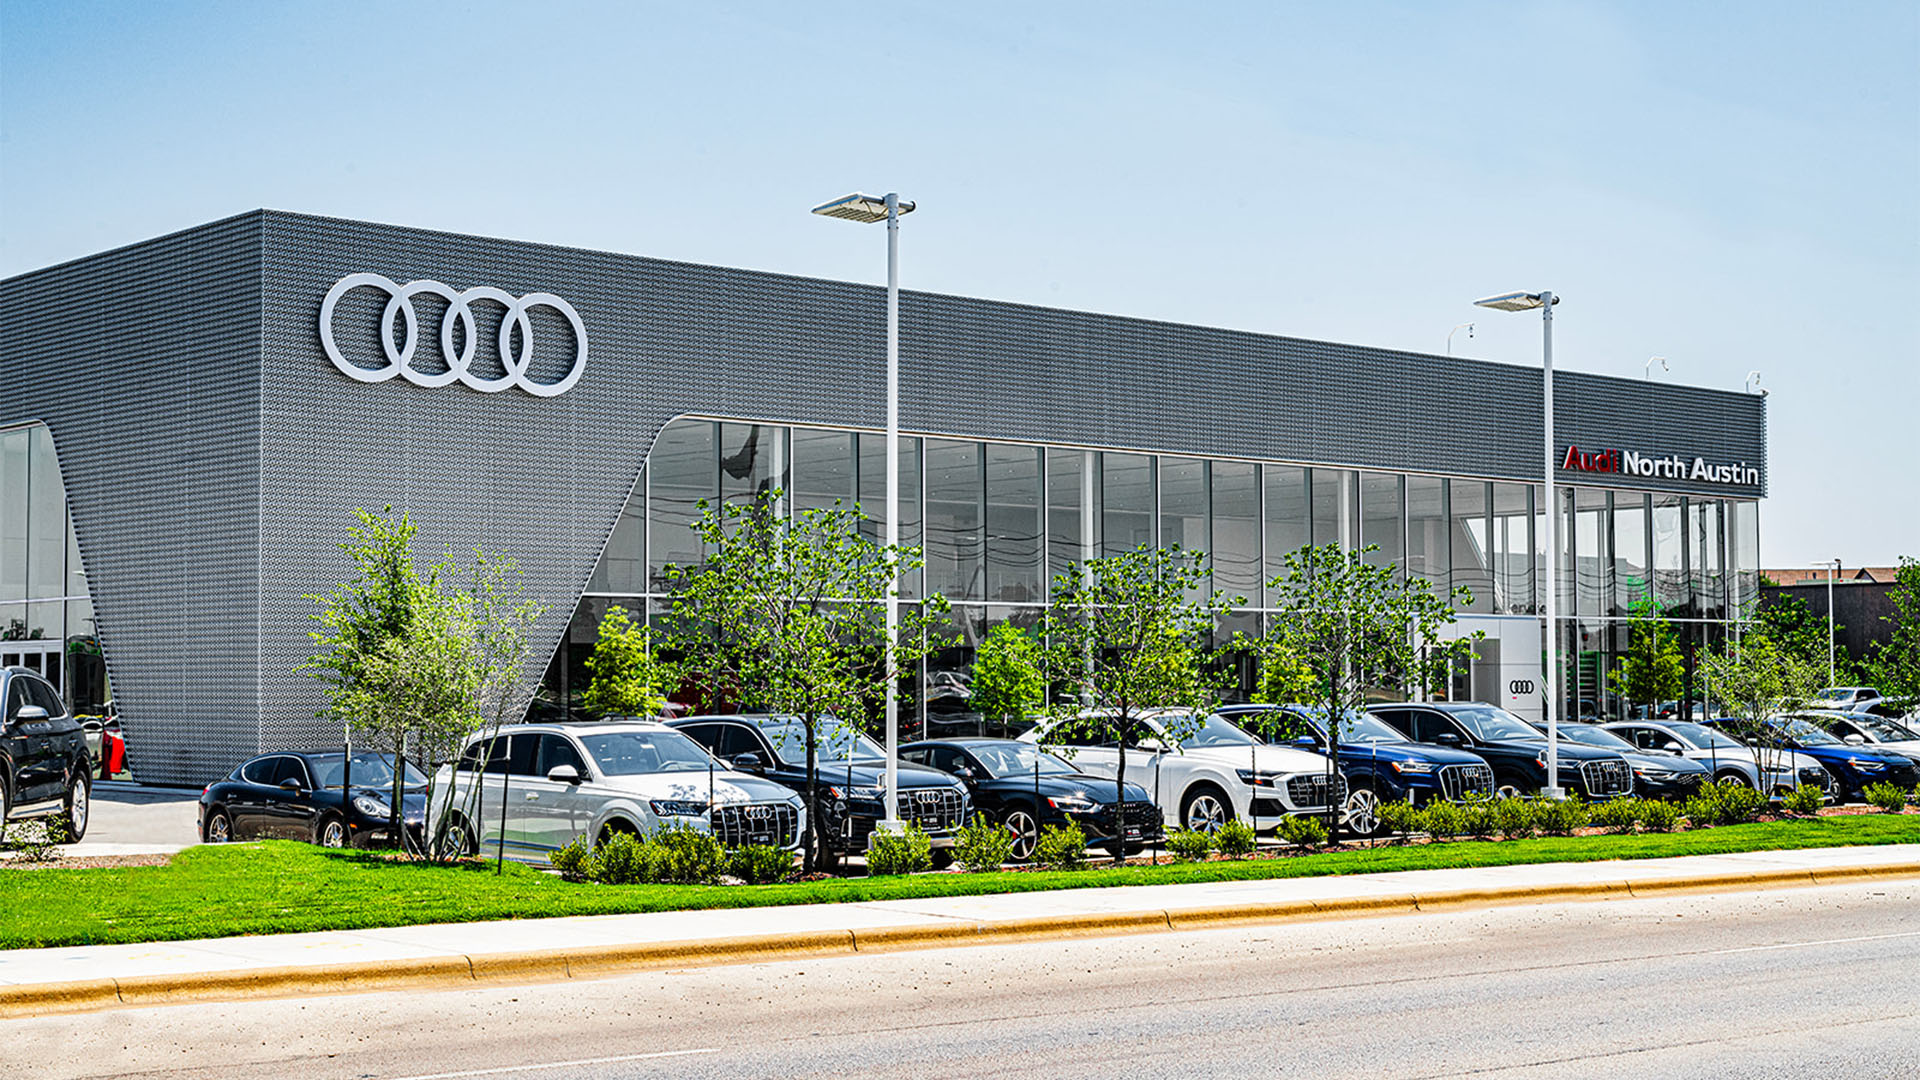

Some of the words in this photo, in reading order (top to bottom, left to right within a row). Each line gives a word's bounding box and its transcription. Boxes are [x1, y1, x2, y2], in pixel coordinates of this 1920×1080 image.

[1563, 446, 1617, 472] Audi
[1623, 451, 1684, 478] North
[1690, 458, 1758, 484] Austin
